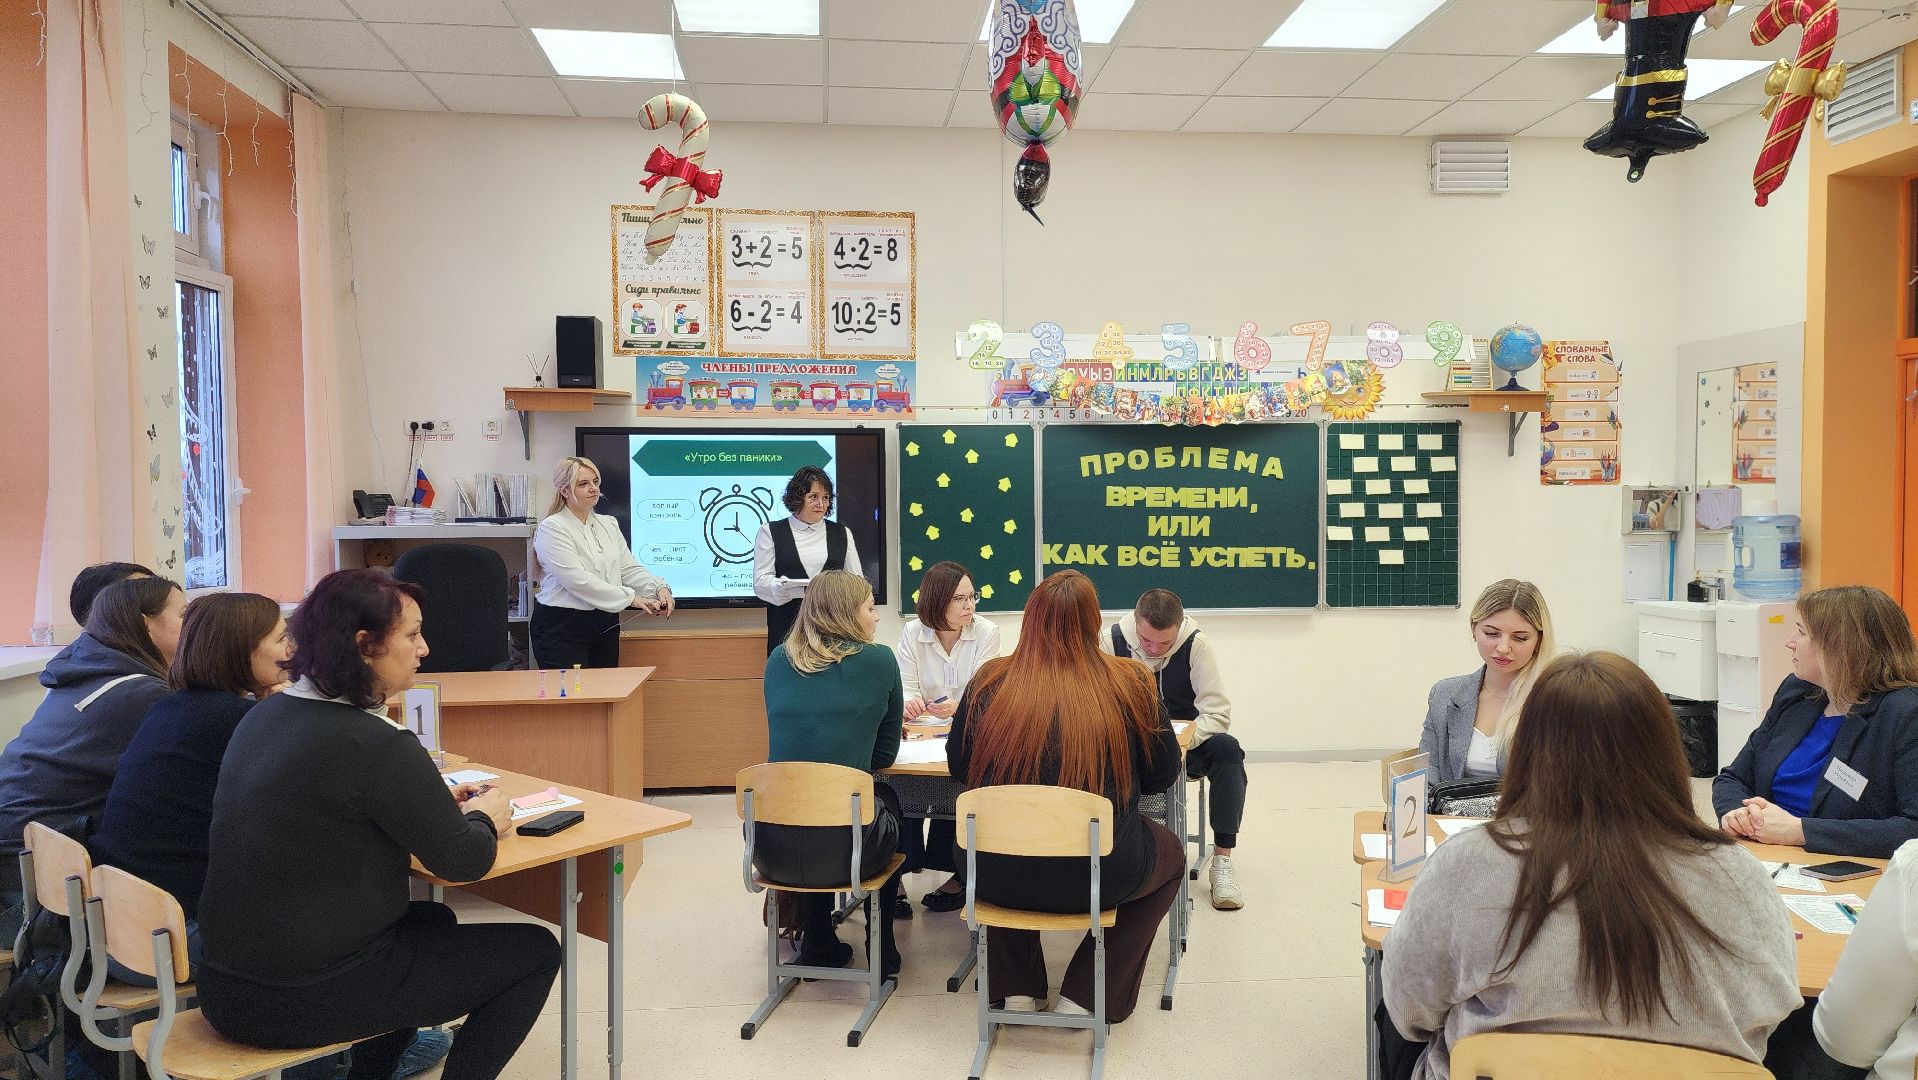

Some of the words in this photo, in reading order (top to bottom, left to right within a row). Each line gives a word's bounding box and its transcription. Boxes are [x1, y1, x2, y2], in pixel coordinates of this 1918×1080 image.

[625, 284, 649, 297] Сиди
[651, 286, 702, 298] правильно
[968, 319, 1006, 370] 2
[1029, 321, 1067, 369] 3
[1092, 320, 1134, 369] 4
[1161, 322, 1199, 370] 5
[1233, 320, 1272, 371] 6
[1289, 319, 1332, 372] 7
[1366, 321, 1403, 368] 8
[1426, 320, 1463, 368] 9
[1555, 345, 1609, 353] СЛОВАРНЫЕ
[702, 362, 752, 374] ЧЛЕНЫ
[755, 363, 857, 375] ПРЕДЛОЖЕНИЯ
[1567, 354, 1596, 363] СЛОВА
[992, 409, 998, 420] 0
[1008, 410, 1013, 419] 1
[1023, 409, 1030, 419] 2
[1038, 409, 1045, 420] 3
[1053, 409, 1060, 419] 4
[1069, 409, 1076, 419] 5
[1084, 409, 1091, 420] 6
[1294, 410, 1307, 418] 20
[684, 452, 717, 465] «Утро
[718, 452, 737, 463] без
[739, 453, 783, 463] паники»
[1079, 446, 1284, 480] ПРОБЛЕМА
[1105, 485, 1258, 514] ВРЕМЕНИ,
[1147, 515, 1211, 537] ИЛИ
[1041, 543, 1109, 567] КАК
[1117, 541, 1181, 568] ВСЁ
[1189, 546, 1317, 571] УСПЕТЬ.
[412, 704, 427, 736] 1
[1402, 795, 1418, 838] 2
